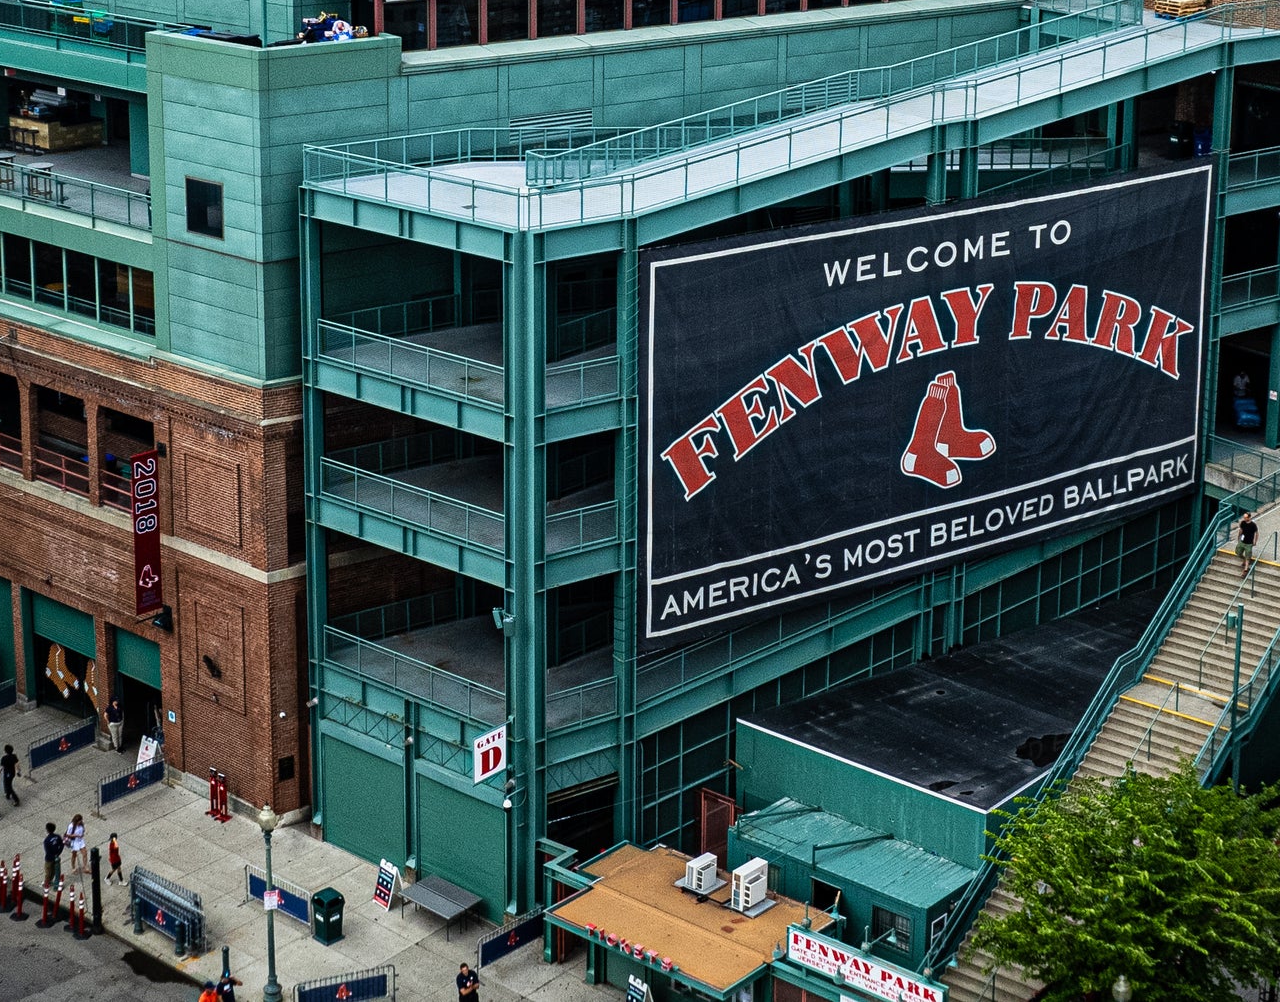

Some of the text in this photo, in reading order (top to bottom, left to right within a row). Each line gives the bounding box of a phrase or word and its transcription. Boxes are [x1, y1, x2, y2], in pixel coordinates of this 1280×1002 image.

[823, 220, 1072, 287] WELCOME TO
[660, 280, 1195, 502] FENWAY PARK
[134, 458, 158, 535] 2018
[660, 453, 1190, 622] AMERICA'S MOST BELOVED BALLPARK
[477, 731, 504, 749] GATE
[480, 746, 502, 776] D
[585, 923, 673, 972] TICKETS
[791, 945, 808, 956] GATE
[849, 969, 885, 989] ENTRANCE
[793, 932, 937, 1002] FENWAY PARK
[798, 955, 825, 970] JERSEY
[865, 982, 878, 992] VAN
